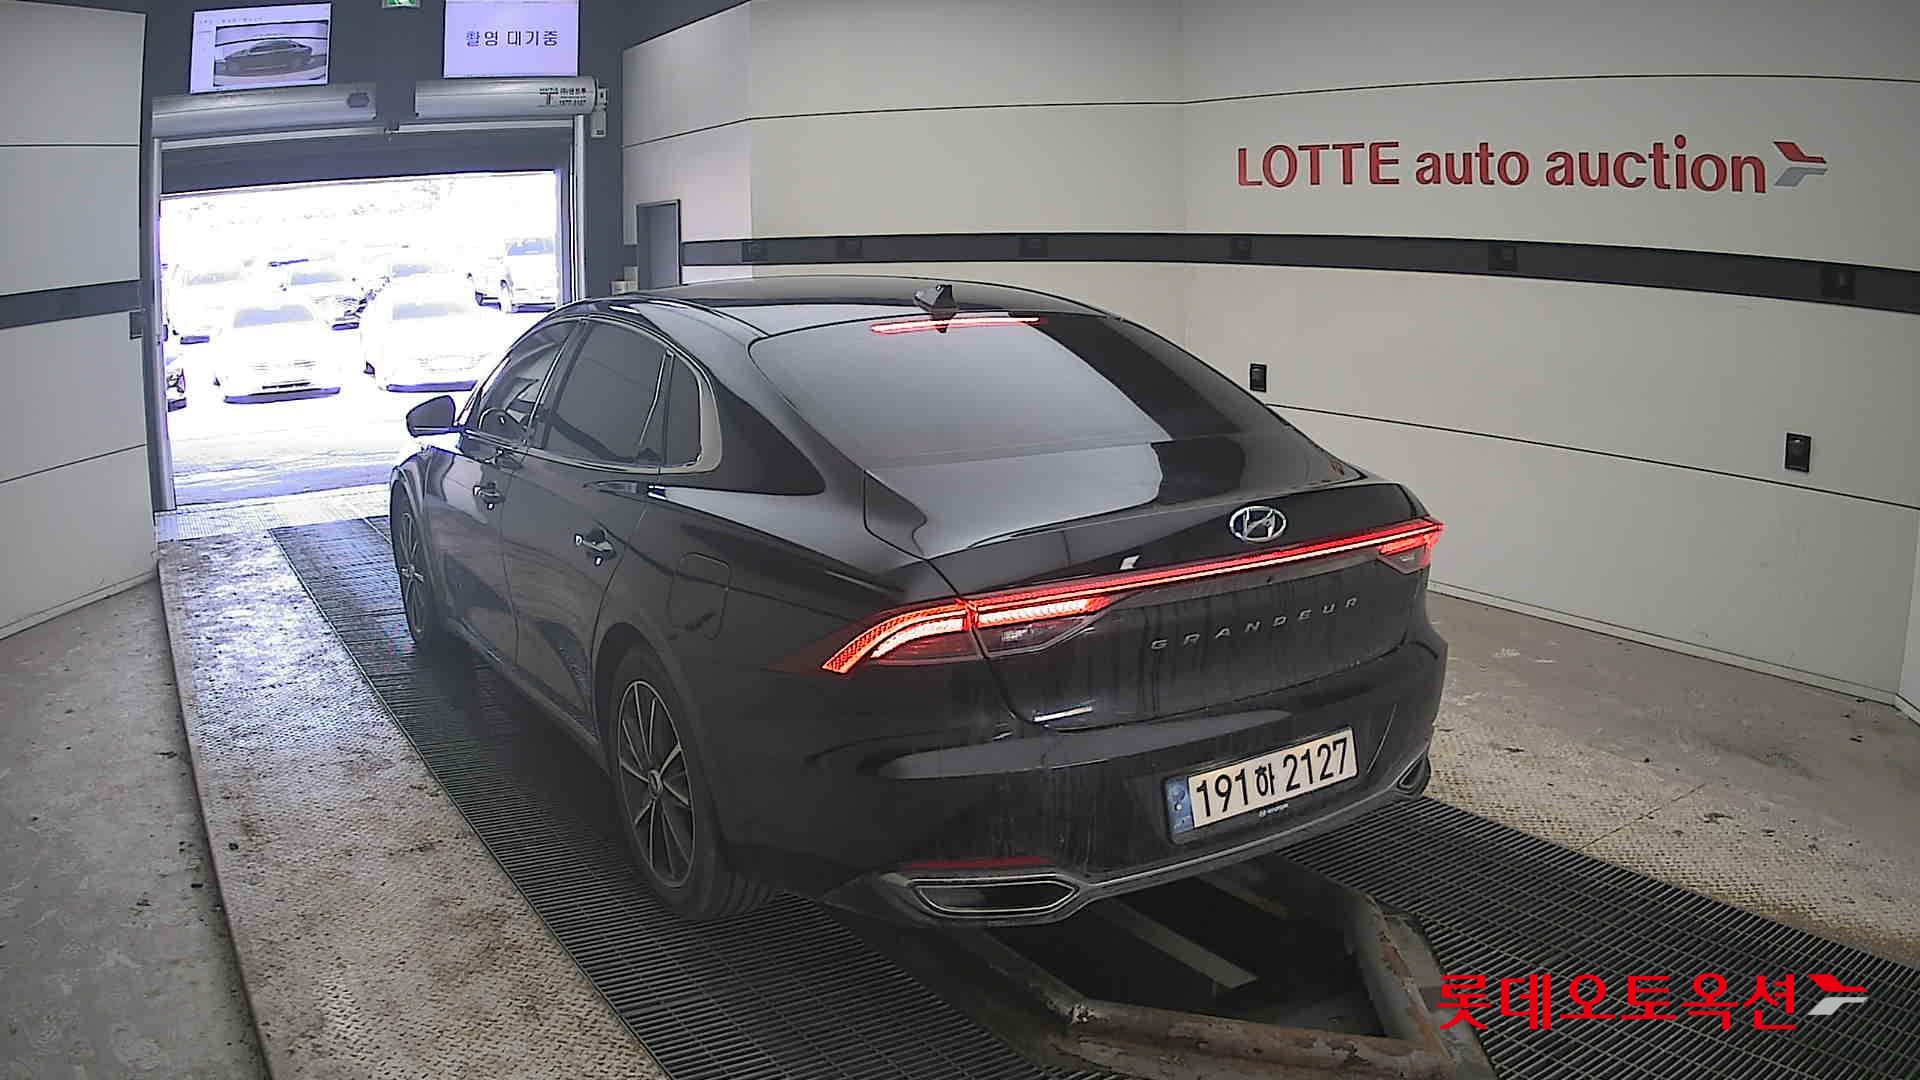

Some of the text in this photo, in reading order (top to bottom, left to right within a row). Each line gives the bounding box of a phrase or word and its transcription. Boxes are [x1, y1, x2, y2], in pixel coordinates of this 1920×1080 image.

[506, 29, 559, 48] 대기중
[1237, 134, 1767, 194] LOTTE auto auction
[1151, 597, 1358, 650] GRANDEUR
[1196, 737, 1348, 818] 191하 2127
